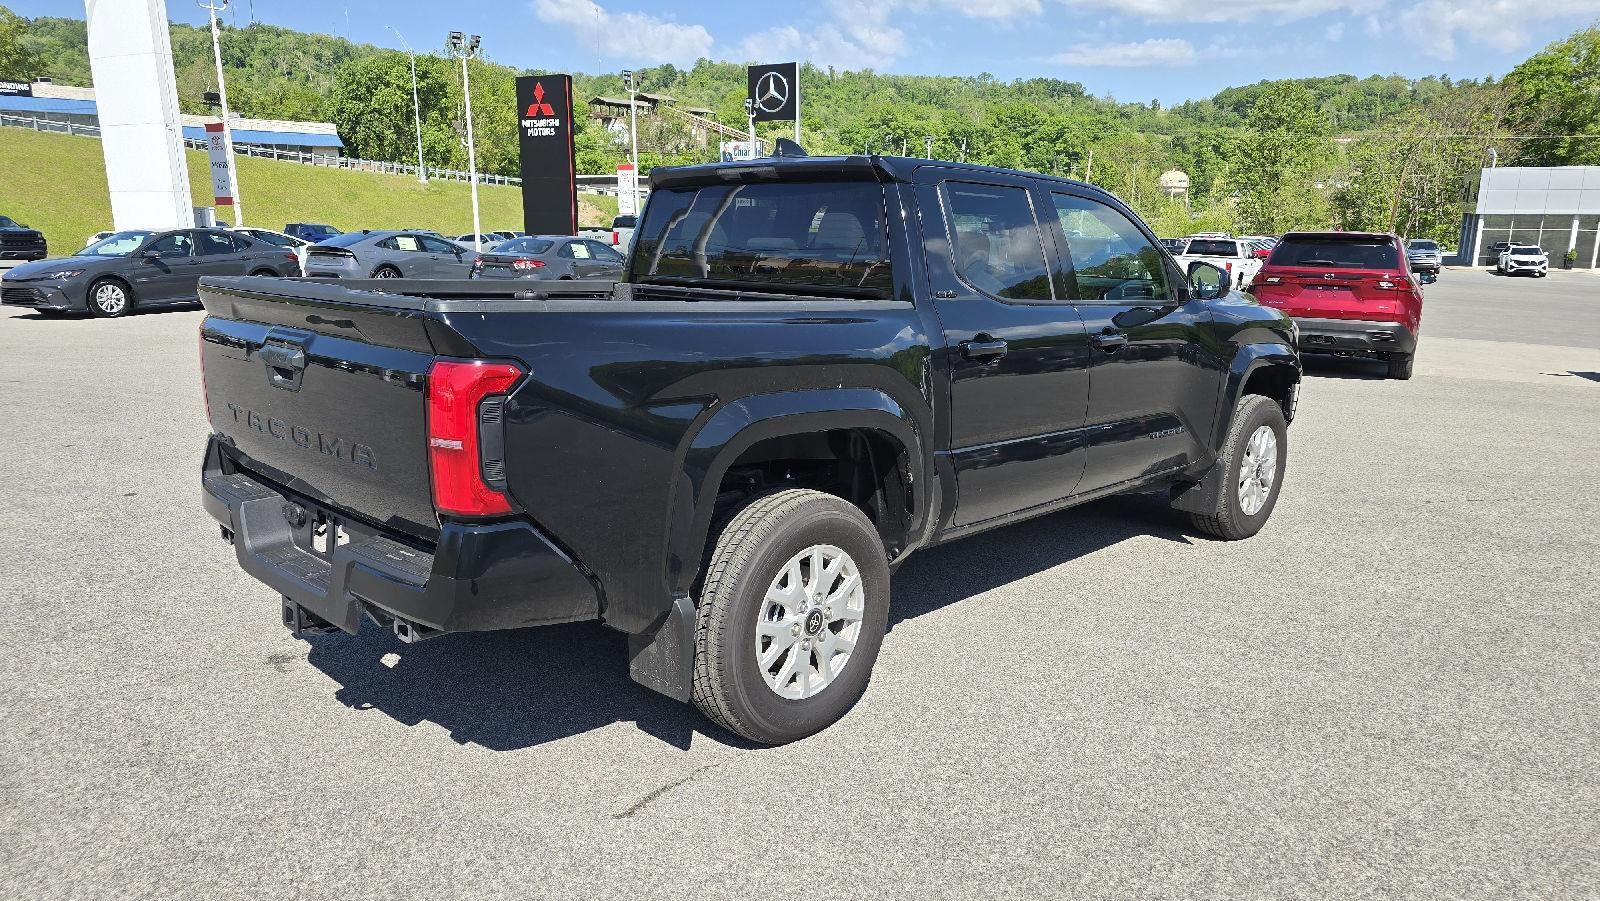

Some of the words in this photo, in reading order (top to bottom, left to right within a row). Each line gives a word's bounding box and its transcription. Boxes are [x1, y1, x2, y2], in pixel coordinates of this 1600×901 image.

[521, 119, 560, 127] MITSUBISHI
[527, 127, 556, 137] MOTORS
[227, 402, 378, 472] TACOMA
